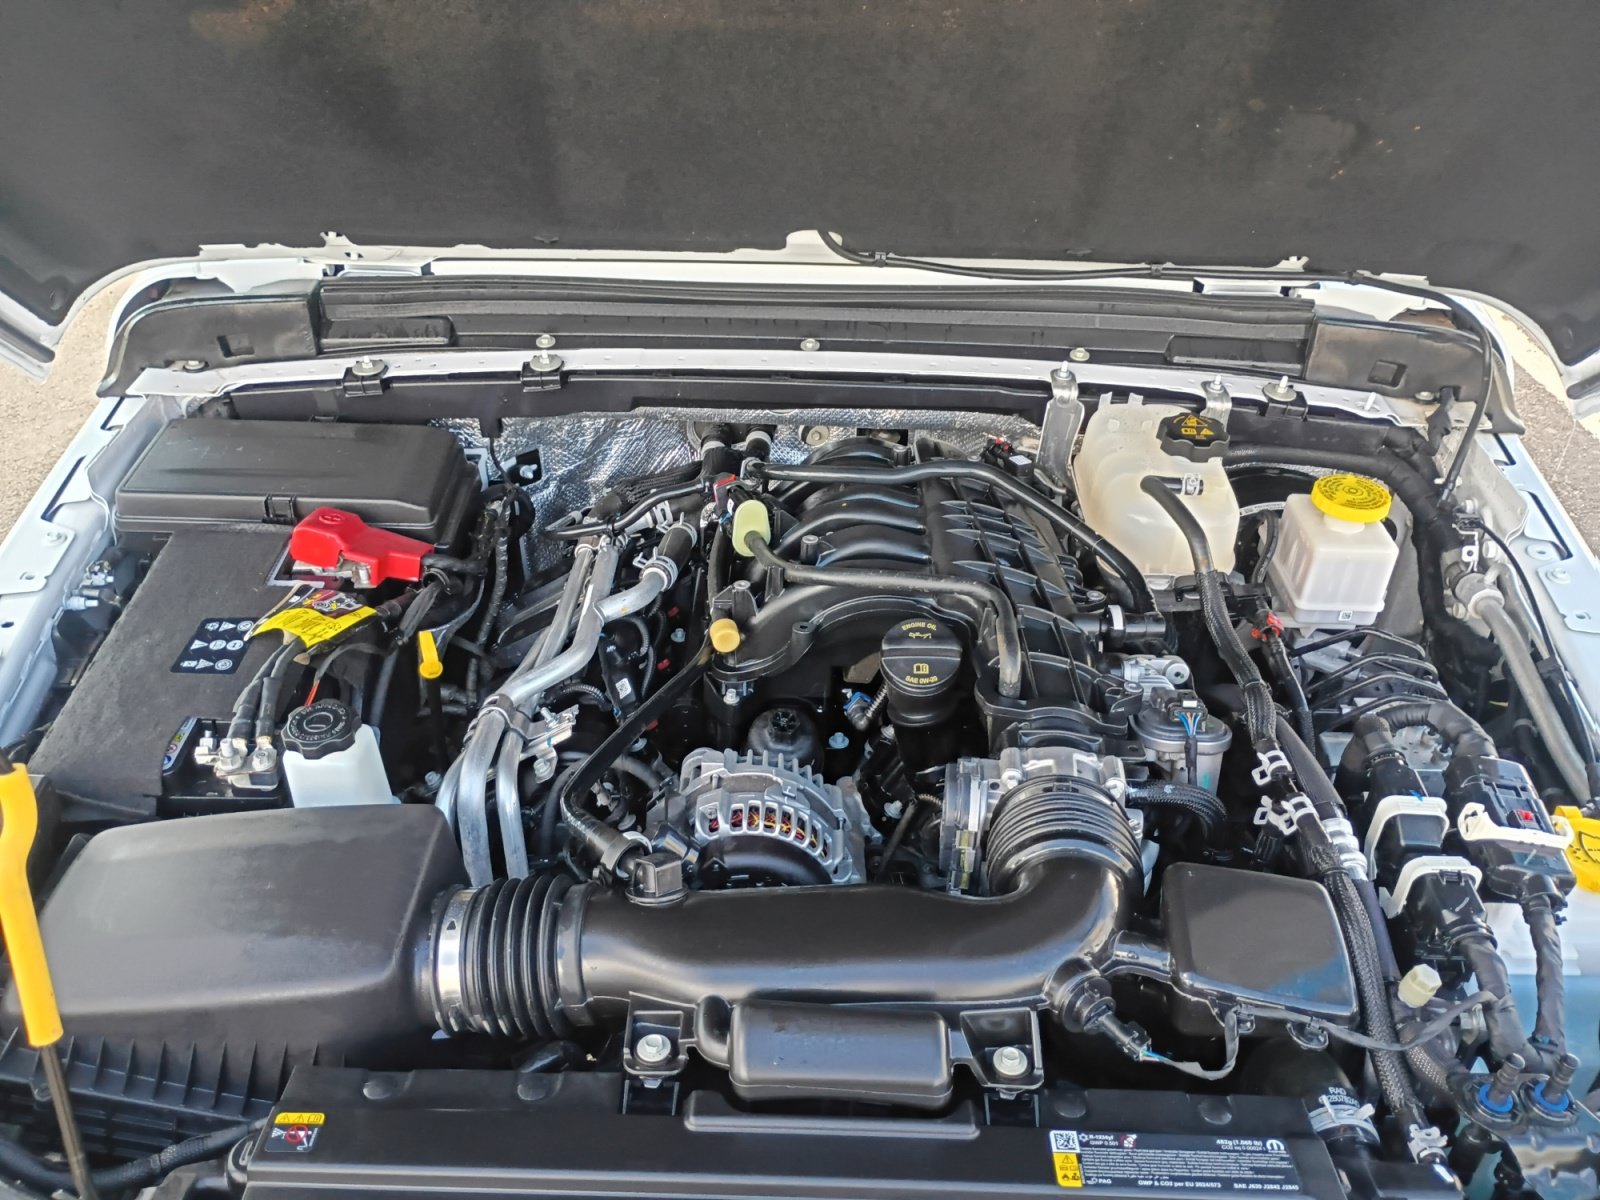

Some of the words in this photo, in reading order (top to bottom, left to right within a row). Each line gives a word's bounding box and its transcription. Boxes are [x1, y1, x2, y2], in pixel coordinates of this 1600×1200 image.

[902, 622, 926, 631] ENGINE
[927, 623, 937, 631] OIL
[905, 675, 919, 684] SAE
[1328, 1086, 1347, 1096] RAD
